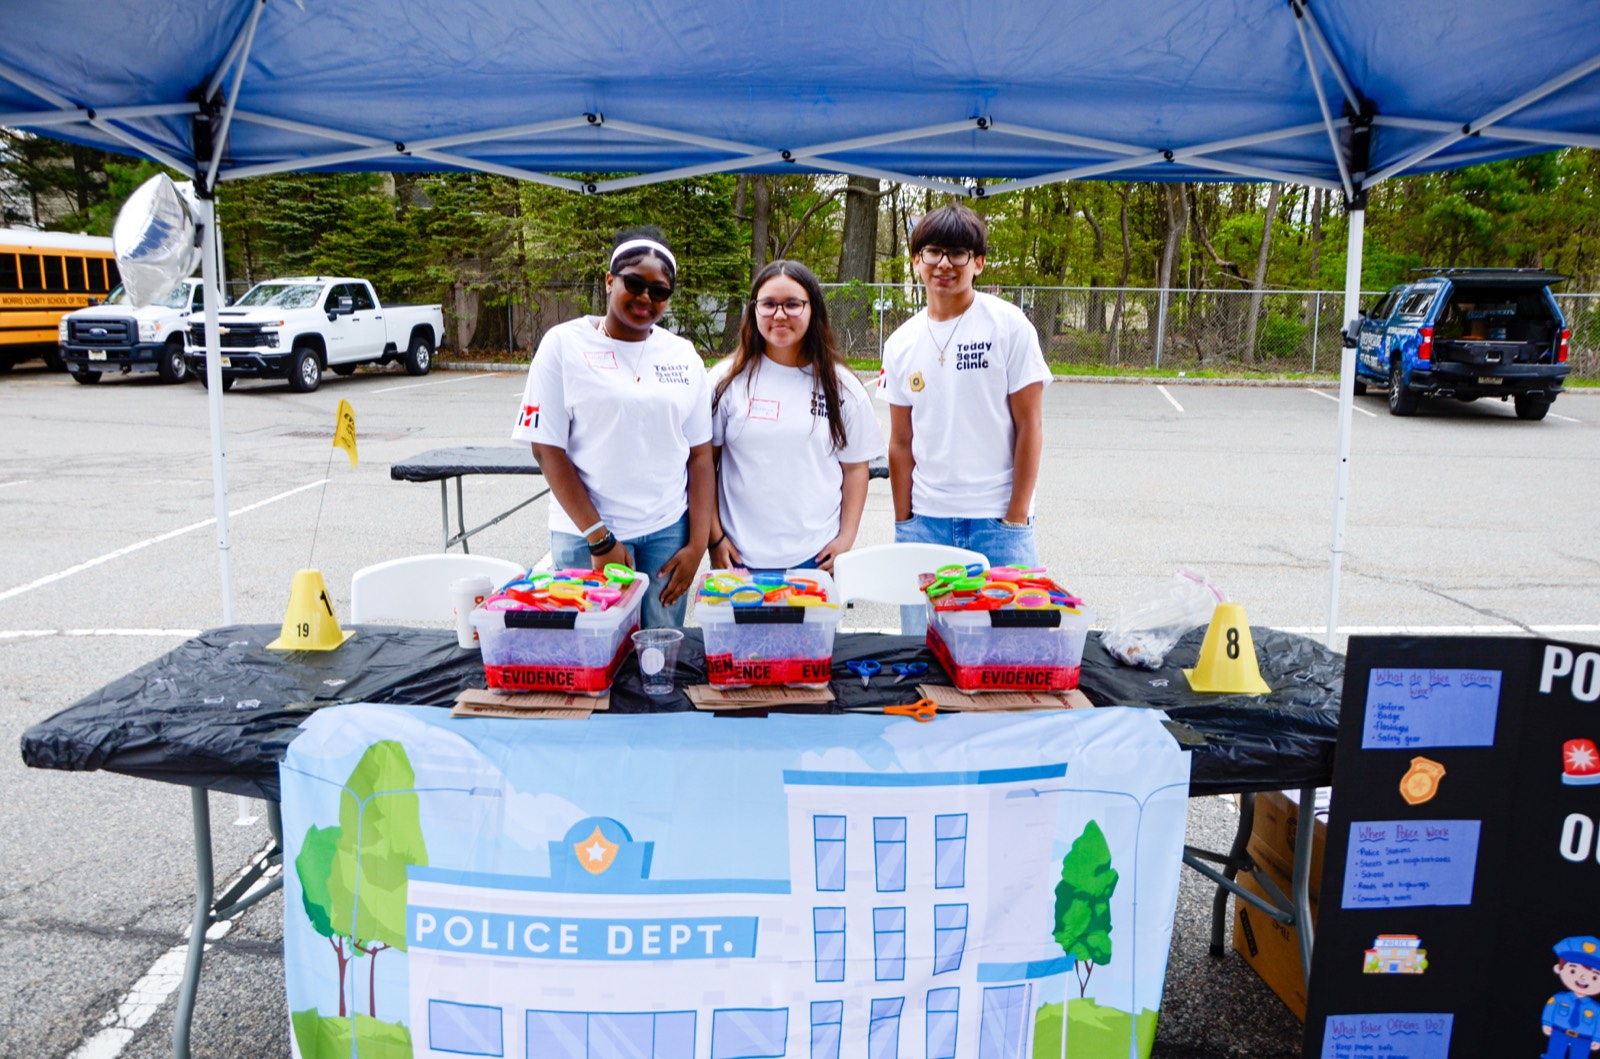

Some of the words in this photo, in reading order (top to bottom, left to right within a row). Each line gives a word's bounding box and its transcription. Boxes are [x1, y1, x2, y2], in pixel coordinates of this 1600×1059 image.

[2, 296, 24, 305] MORRIS
[24, 296, 46, 305] COUNTY
[47, 296, 67, 305] SCHOOL
[68, 296, 75, 304] OF
[956, 341, 992, 352] Teddy
[956, 352, 984, 361] Bear
[653, 364, 689, 372] Teddy
[956, 359, 989, 370] Clinic
[658, 377, 690, 386] Clinic
[319, 589, 333, 616] 1
[296, 622, 310, 638] 19
[1226, 627, 1240, 660] 8
[502, 670, 575, 687] EVIDENCE
[981, 671, 1054, 686] EVIDENCE
[1376, 669, 1404, 681] What
[1410, 672, 1422, 681] do
[1377, 702, 1405, 711] Uniform
[1377, 712, 1400, 723] Badge
[1360, 826, 1386, 838] Where
[1396, 825, 1419, 838] Police
[1426, 826, 1449, 837] Work
[1360, 847, 1379, 856] Police
[1358, 881, 1376, 889] Roads
[1358, 894, 1390, 904] Community
[415, 912, 580, 953] POLICE
[606, 924, 734, 955] DEPT.
[1331, 1020, 1356, 1035] What
[1360, 1020, 1381, 1032] Police
